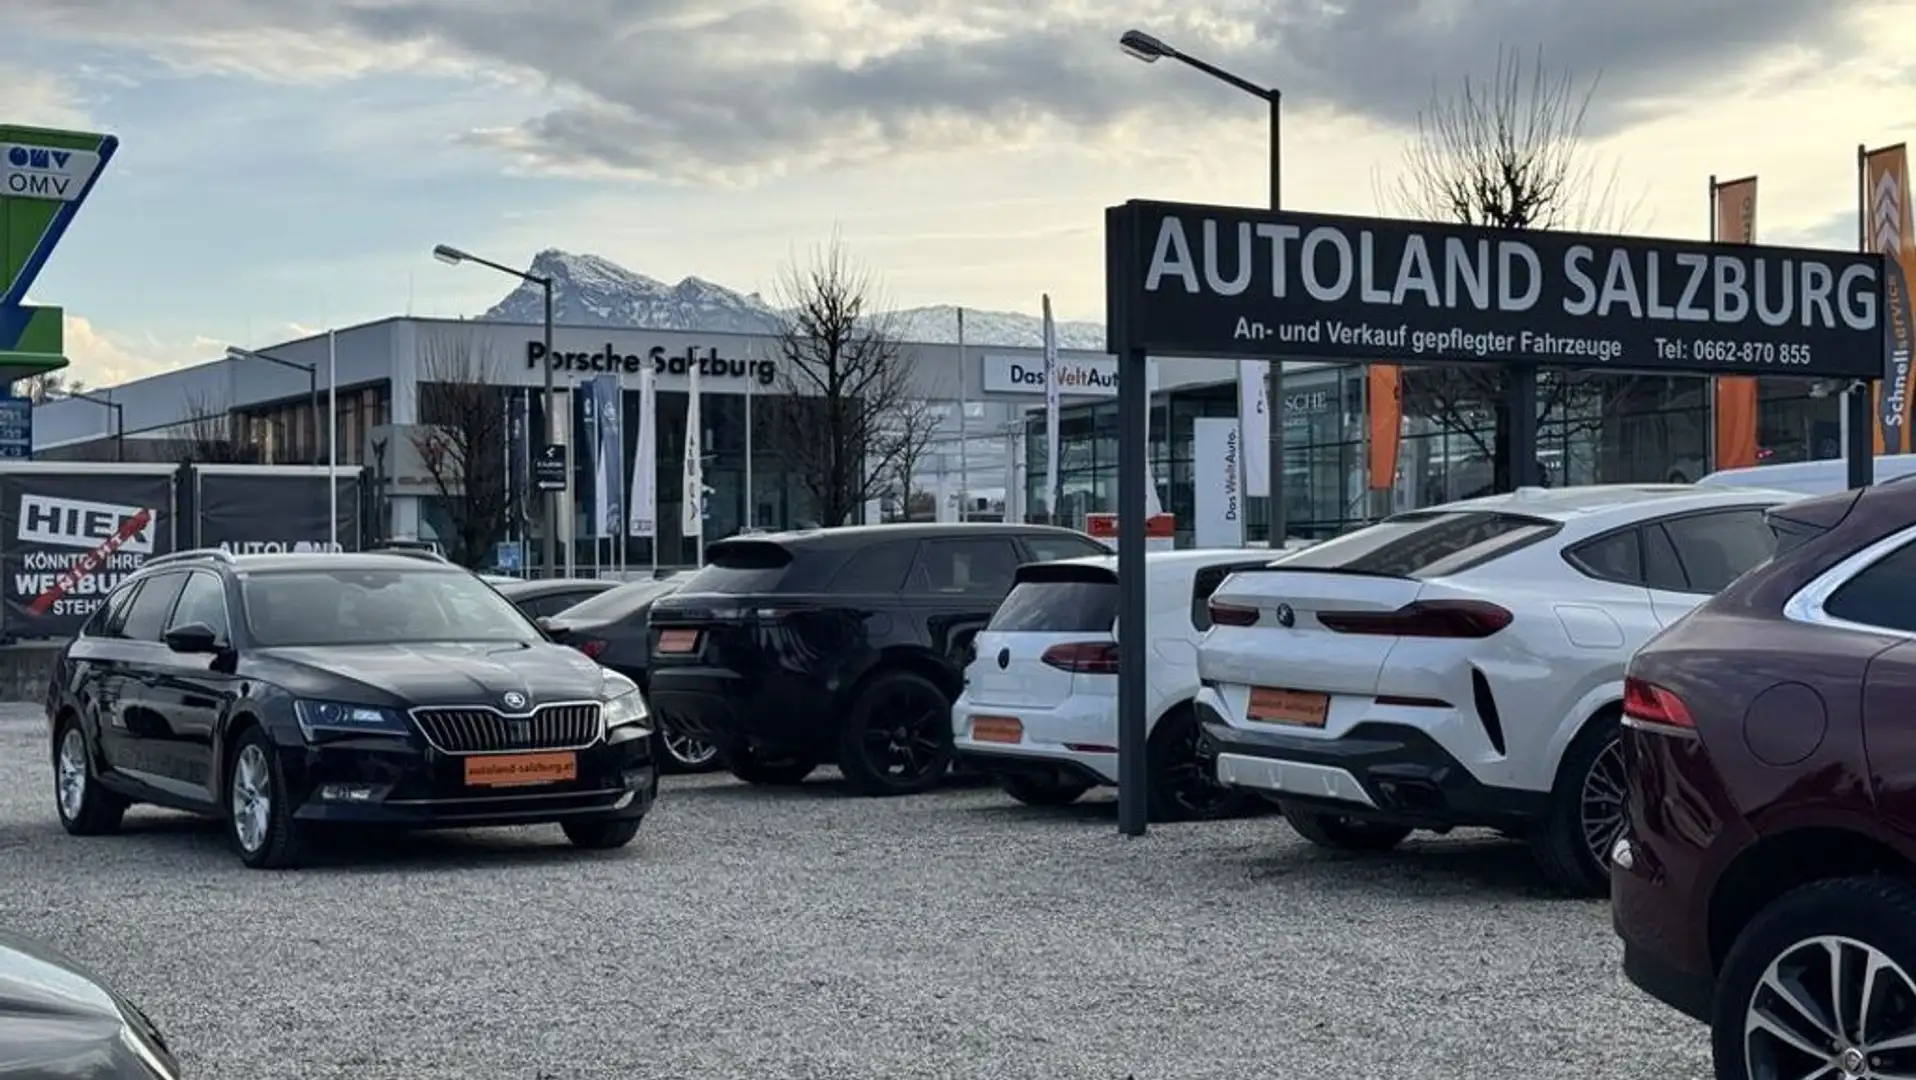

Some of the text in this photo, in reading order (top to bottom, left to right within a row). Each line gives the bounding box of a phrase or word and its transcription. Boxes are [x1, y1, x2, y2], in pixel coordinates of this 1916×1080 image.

[9, 172, 70, 195] OMV
[1145, 216, 1876, 330] AUTOLAND SALZBURG
[1234, 316, 1811, 365] An- und Verkauf gepflegter Fahrzeuge Tel: 0662-870 855
[528, 341, 775, 385] Porsche Salzburg
[1011, 364, 1120, 387] Das WeltAut
[1284, 391, 1328, 411] SCHE
[1225, 495, 1237, 521] Das
[26, 504, 148, 543] HIER
[106, 553, 144, 570] IHRE
[15, 572, 126, 595] WERBU
[53, 598, 102, 616] STEH
